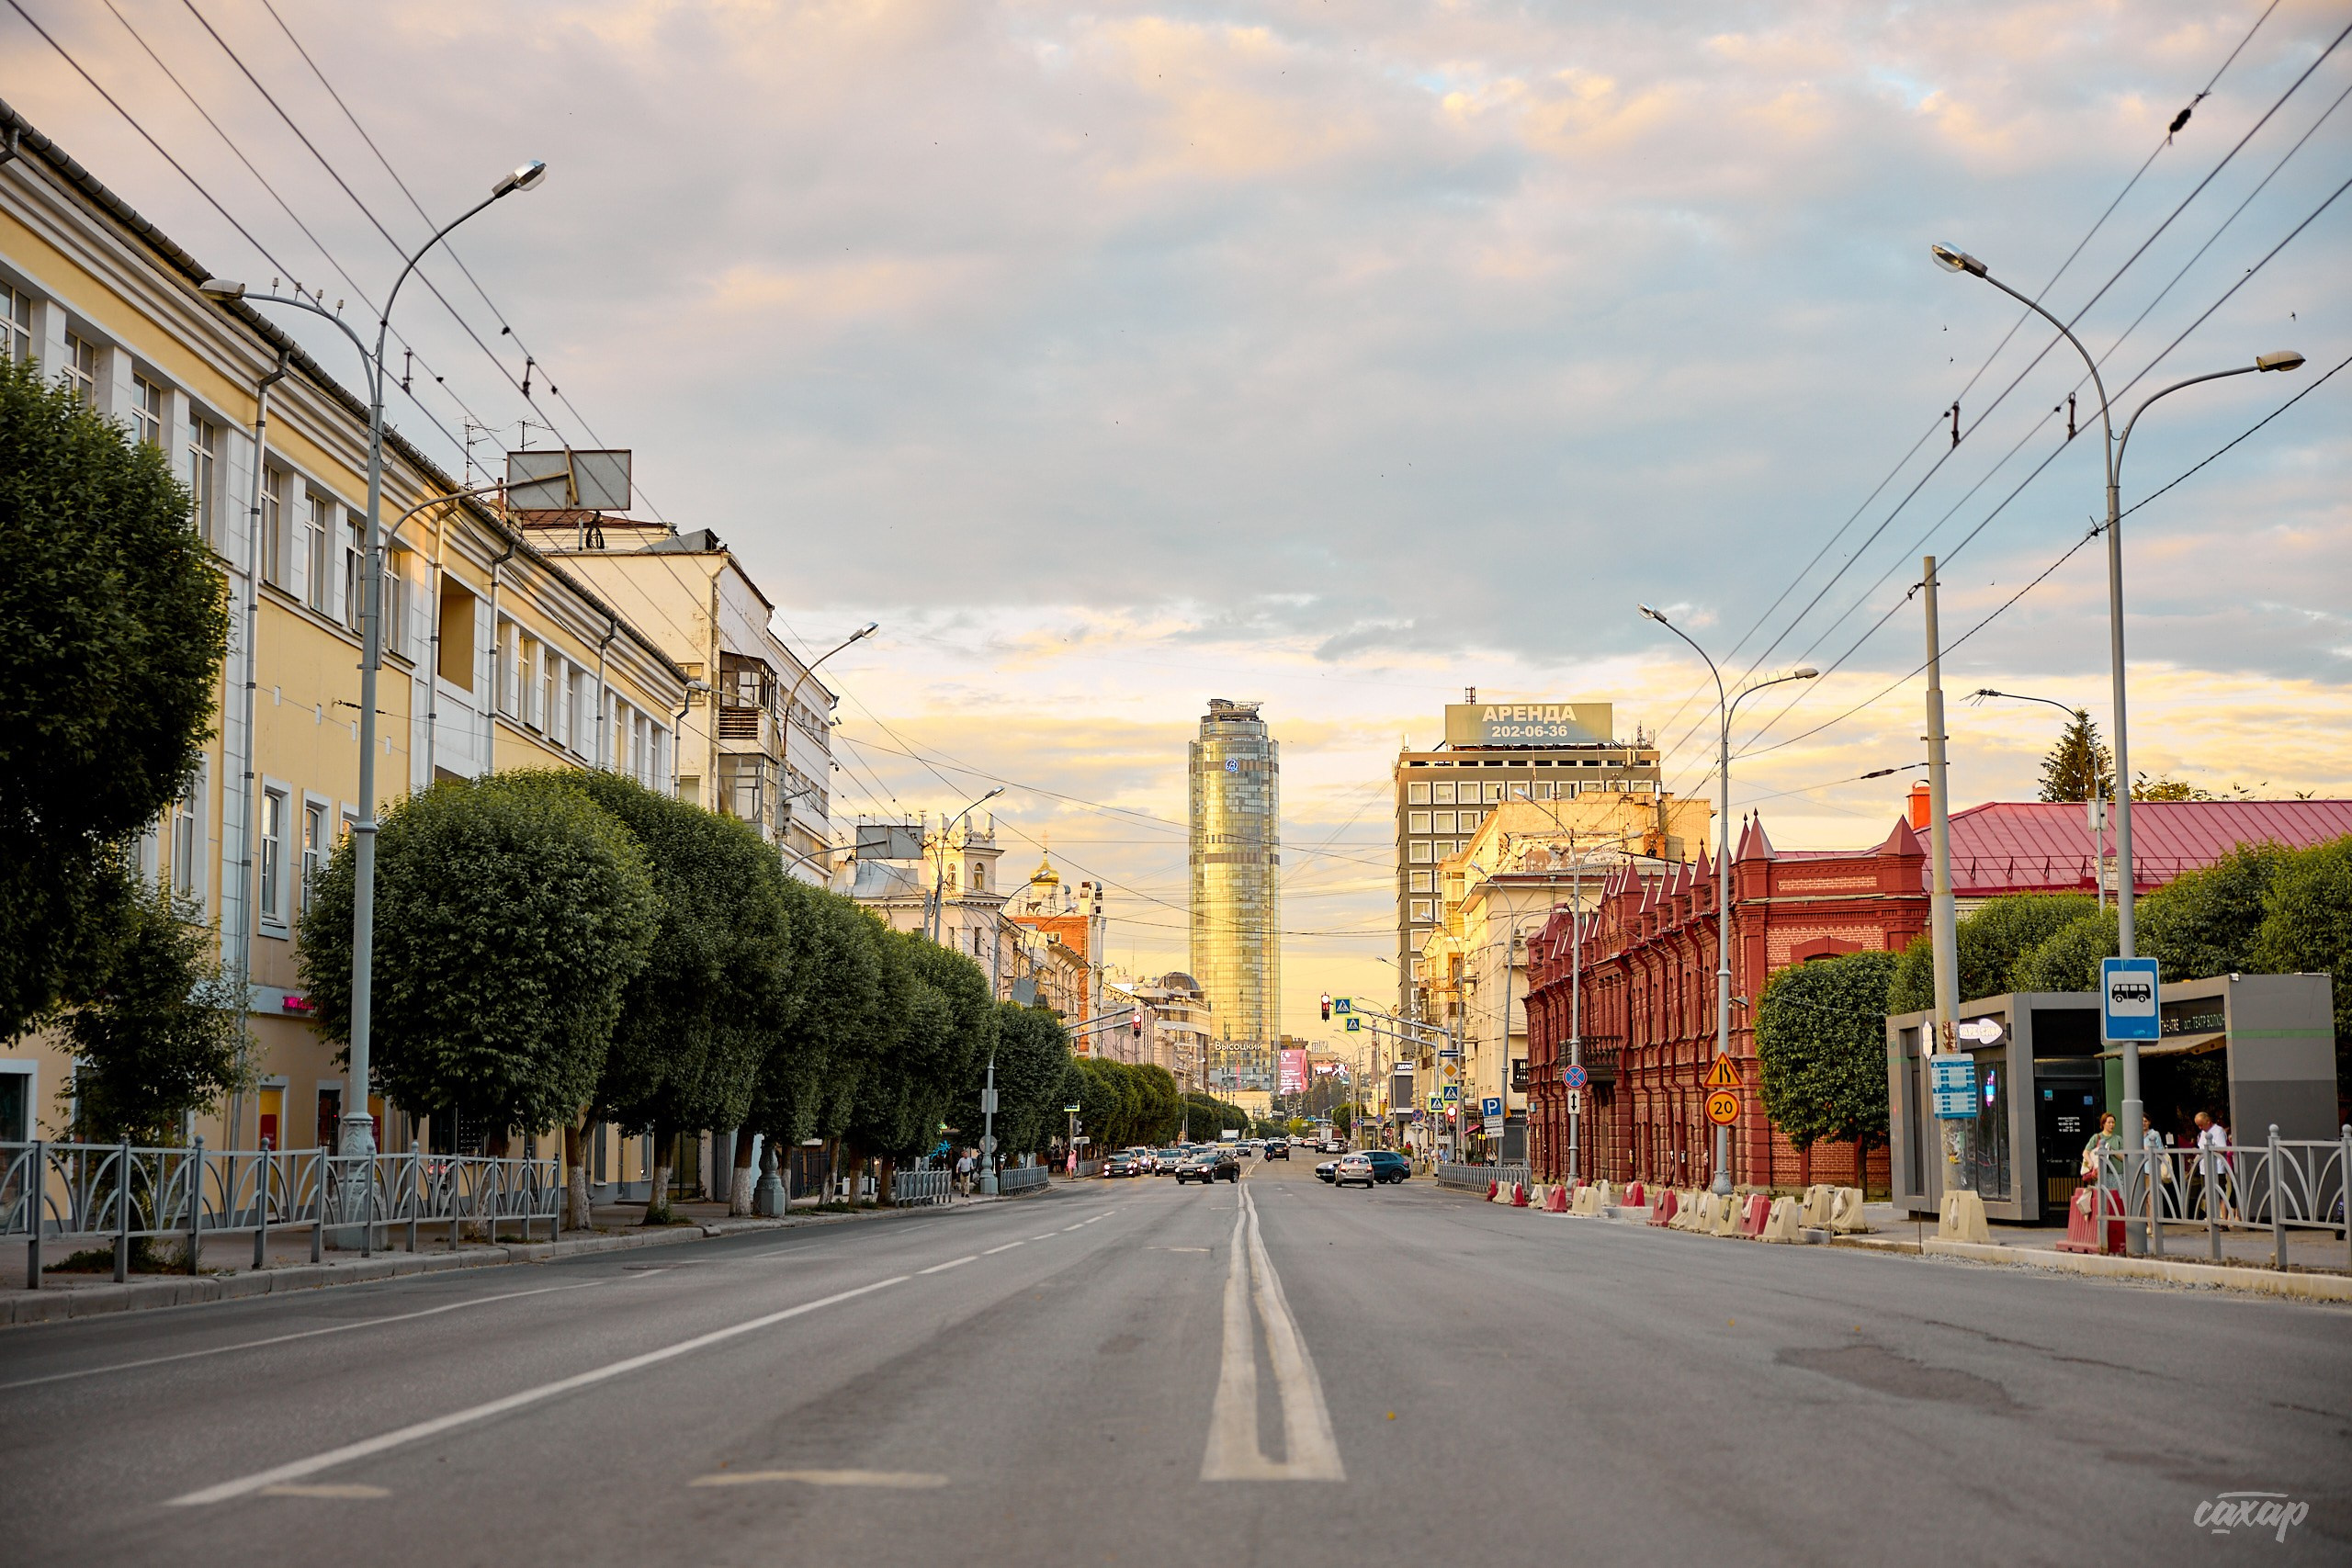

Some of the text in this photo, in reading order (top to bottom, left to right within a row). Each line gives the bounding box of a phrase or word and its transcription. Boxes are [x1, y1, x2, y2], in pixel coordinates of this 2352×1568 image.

[1482, 705, 1577, 724] АРЕНДА
[1491, 725, 1567, 738] 202-06-36
[1215, 1041, 1263, 1051] Высоцкий
[1714, 1100, 1733, 1115] 20
